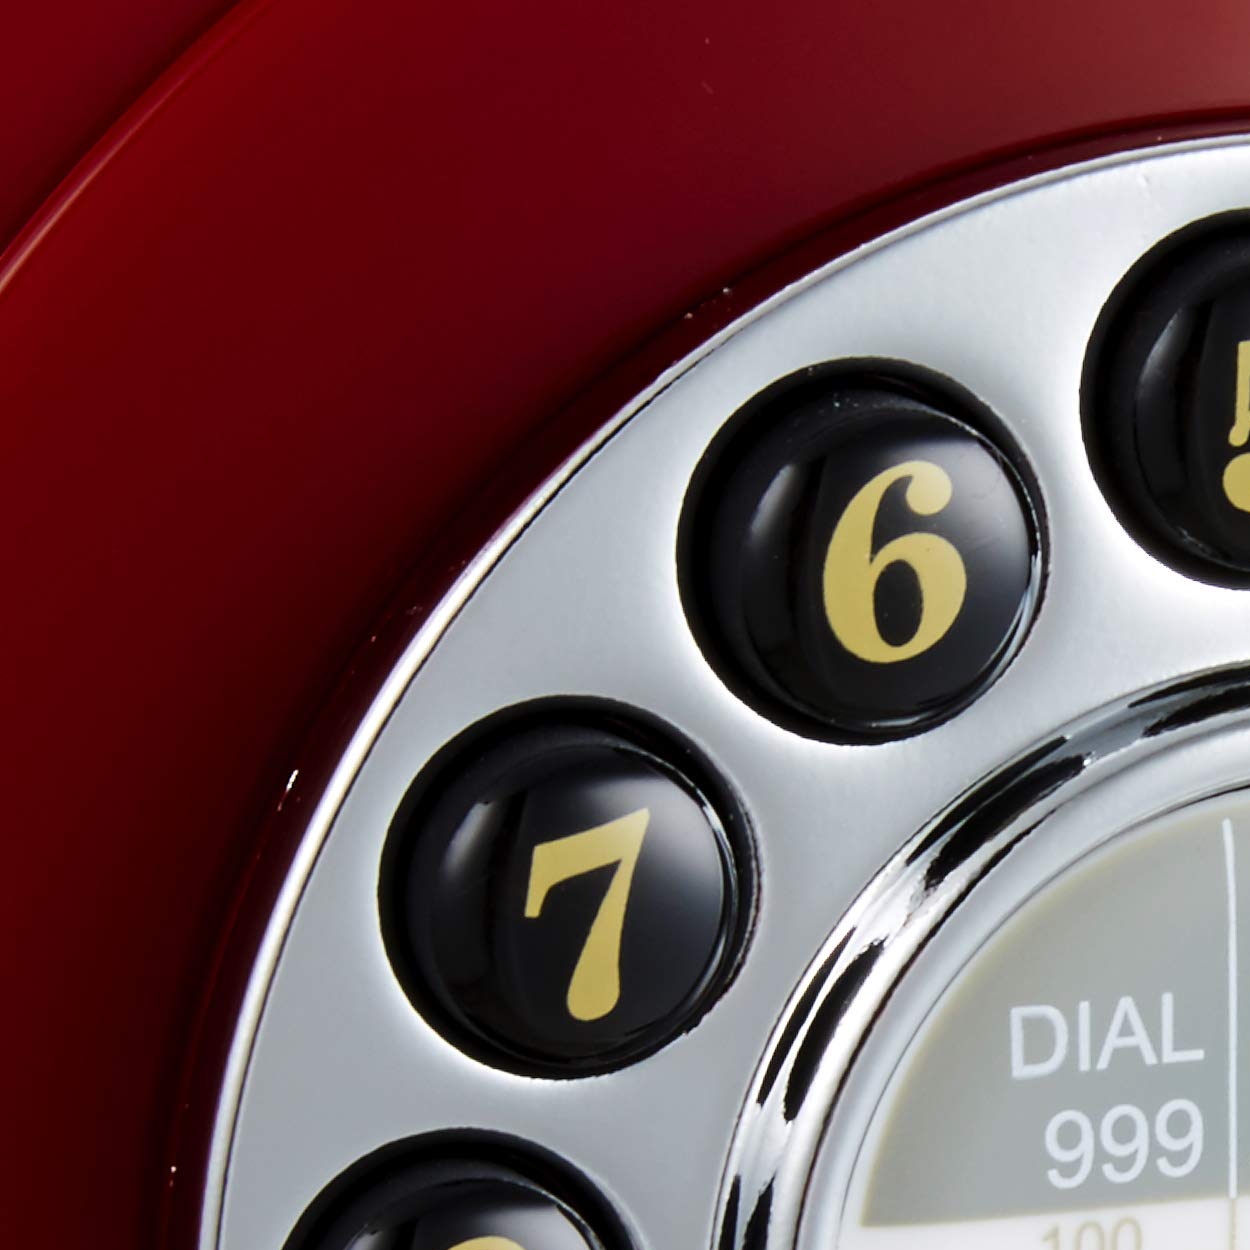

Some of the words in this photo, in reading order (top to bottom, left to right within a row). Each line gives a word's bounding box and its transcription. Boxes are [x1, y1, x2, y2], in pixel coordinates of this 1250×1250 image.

[821, 458, 970, 665] 6
[523, 806, 653, 1023] 7
[1008, 991, 1206, 1081] DIAL
[1044, 1097, 1204, 1191] 999
